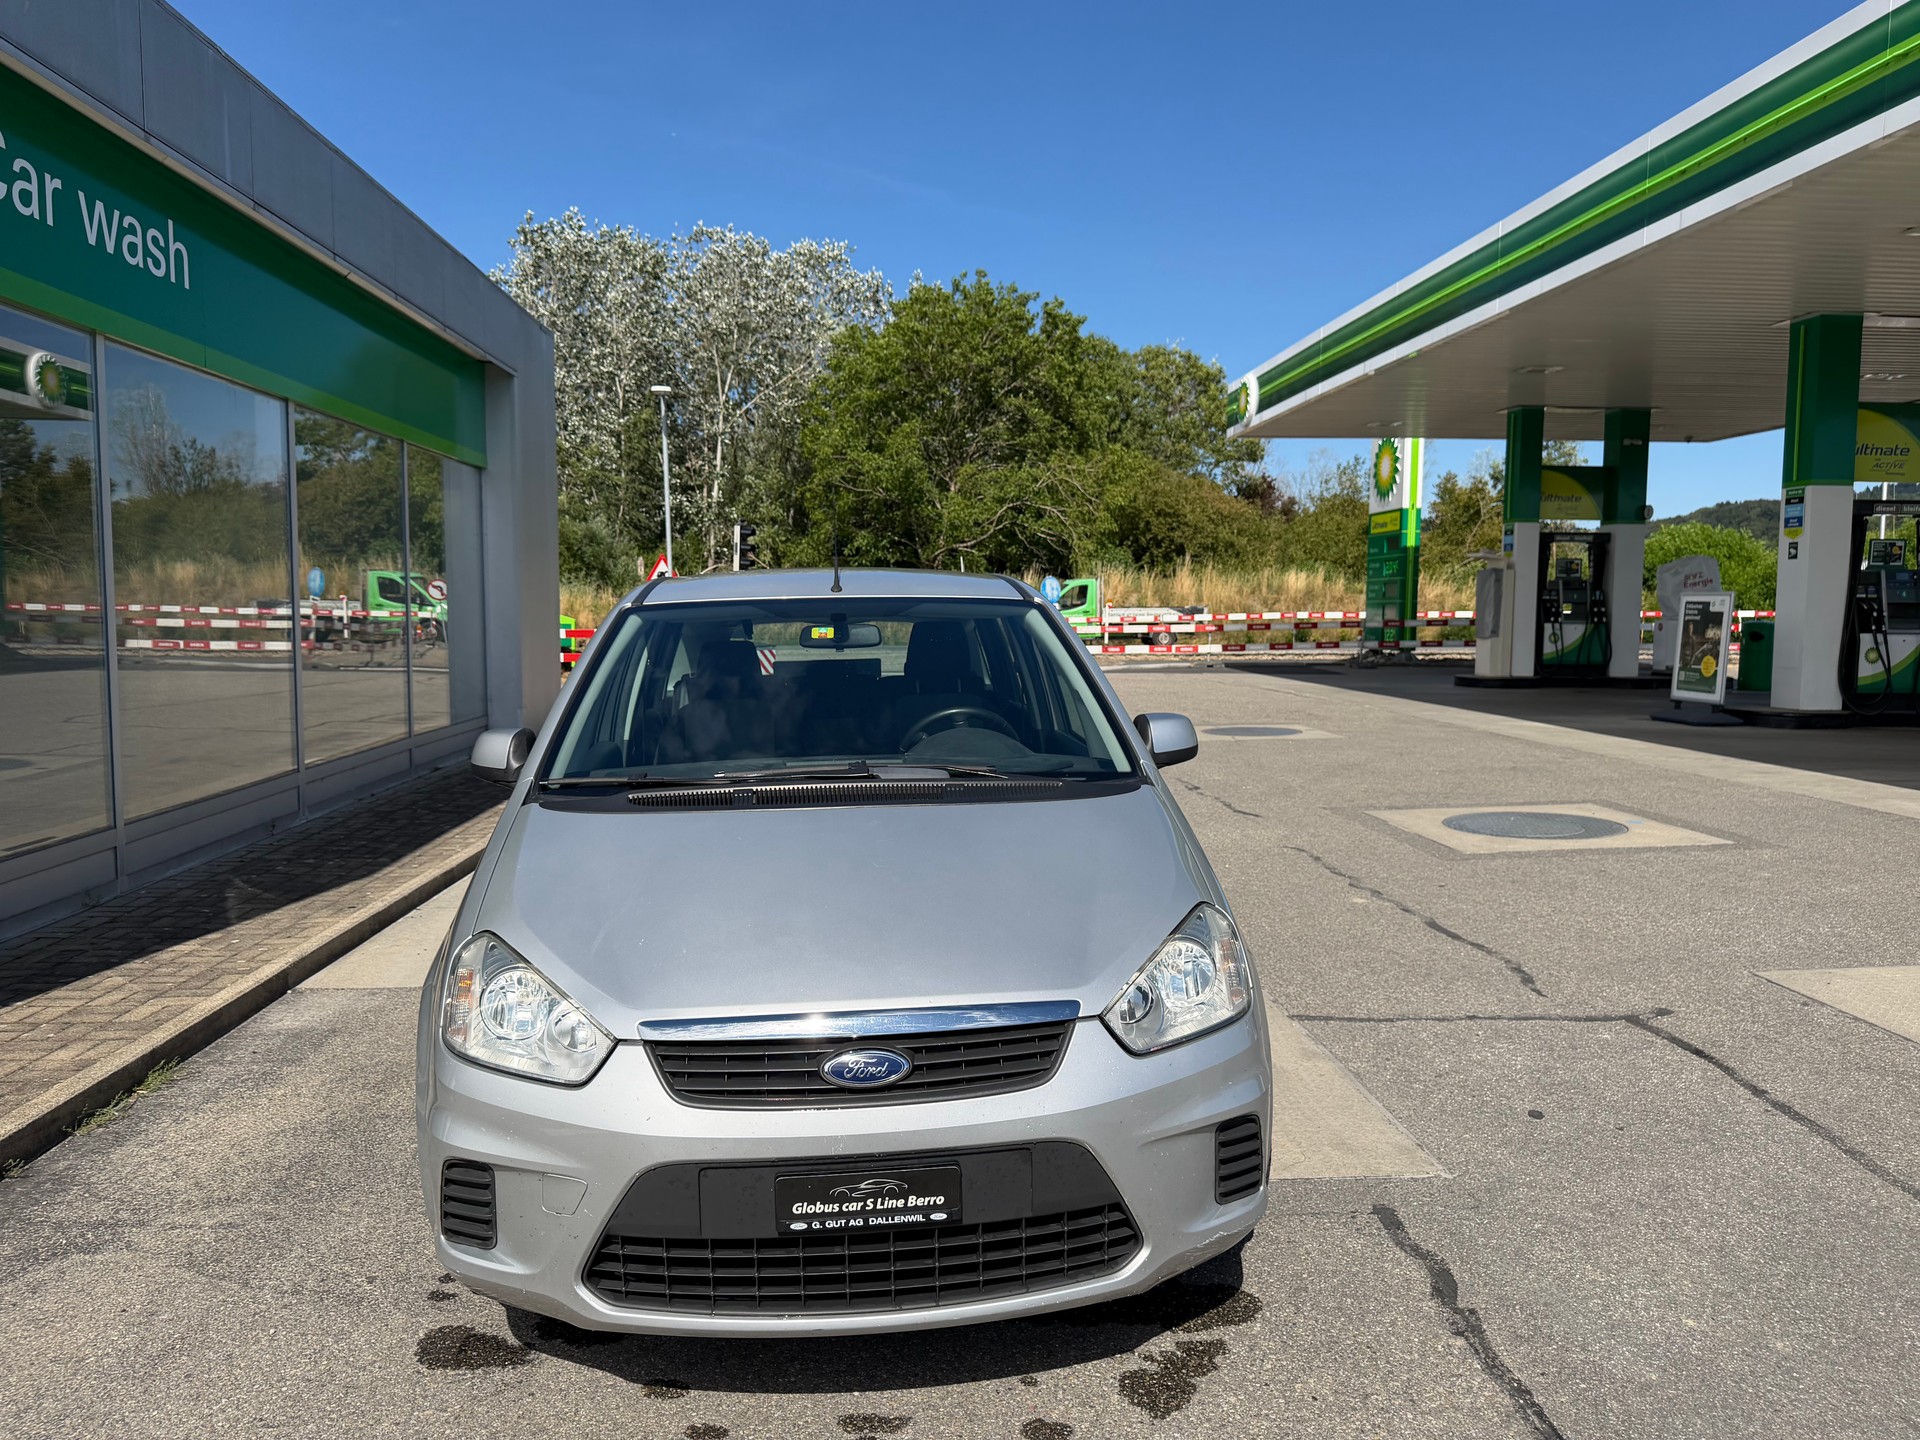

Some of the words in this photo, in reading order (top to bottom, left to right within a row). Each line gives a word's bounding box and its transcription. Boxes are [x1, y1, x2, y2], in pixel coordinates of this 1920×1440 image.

[78, 189, 190, 290] wash
[843, 1058, 889, 1079] Ford
[792, 1201, 840, 1214] Globus
[842, 1201, 864, 1211] car
[865, 1199, 874, 1210] S
[876, 1197, 904, 1209] Line
[907, 1195, 945, 1207] Berro
[812, 1221, 823, 1229] G.
[825, 1219, 847, 1228] GUT
[849, 1218, 864, 1226] AG
[869, 1214, 926, 1225] DALLENWIL
